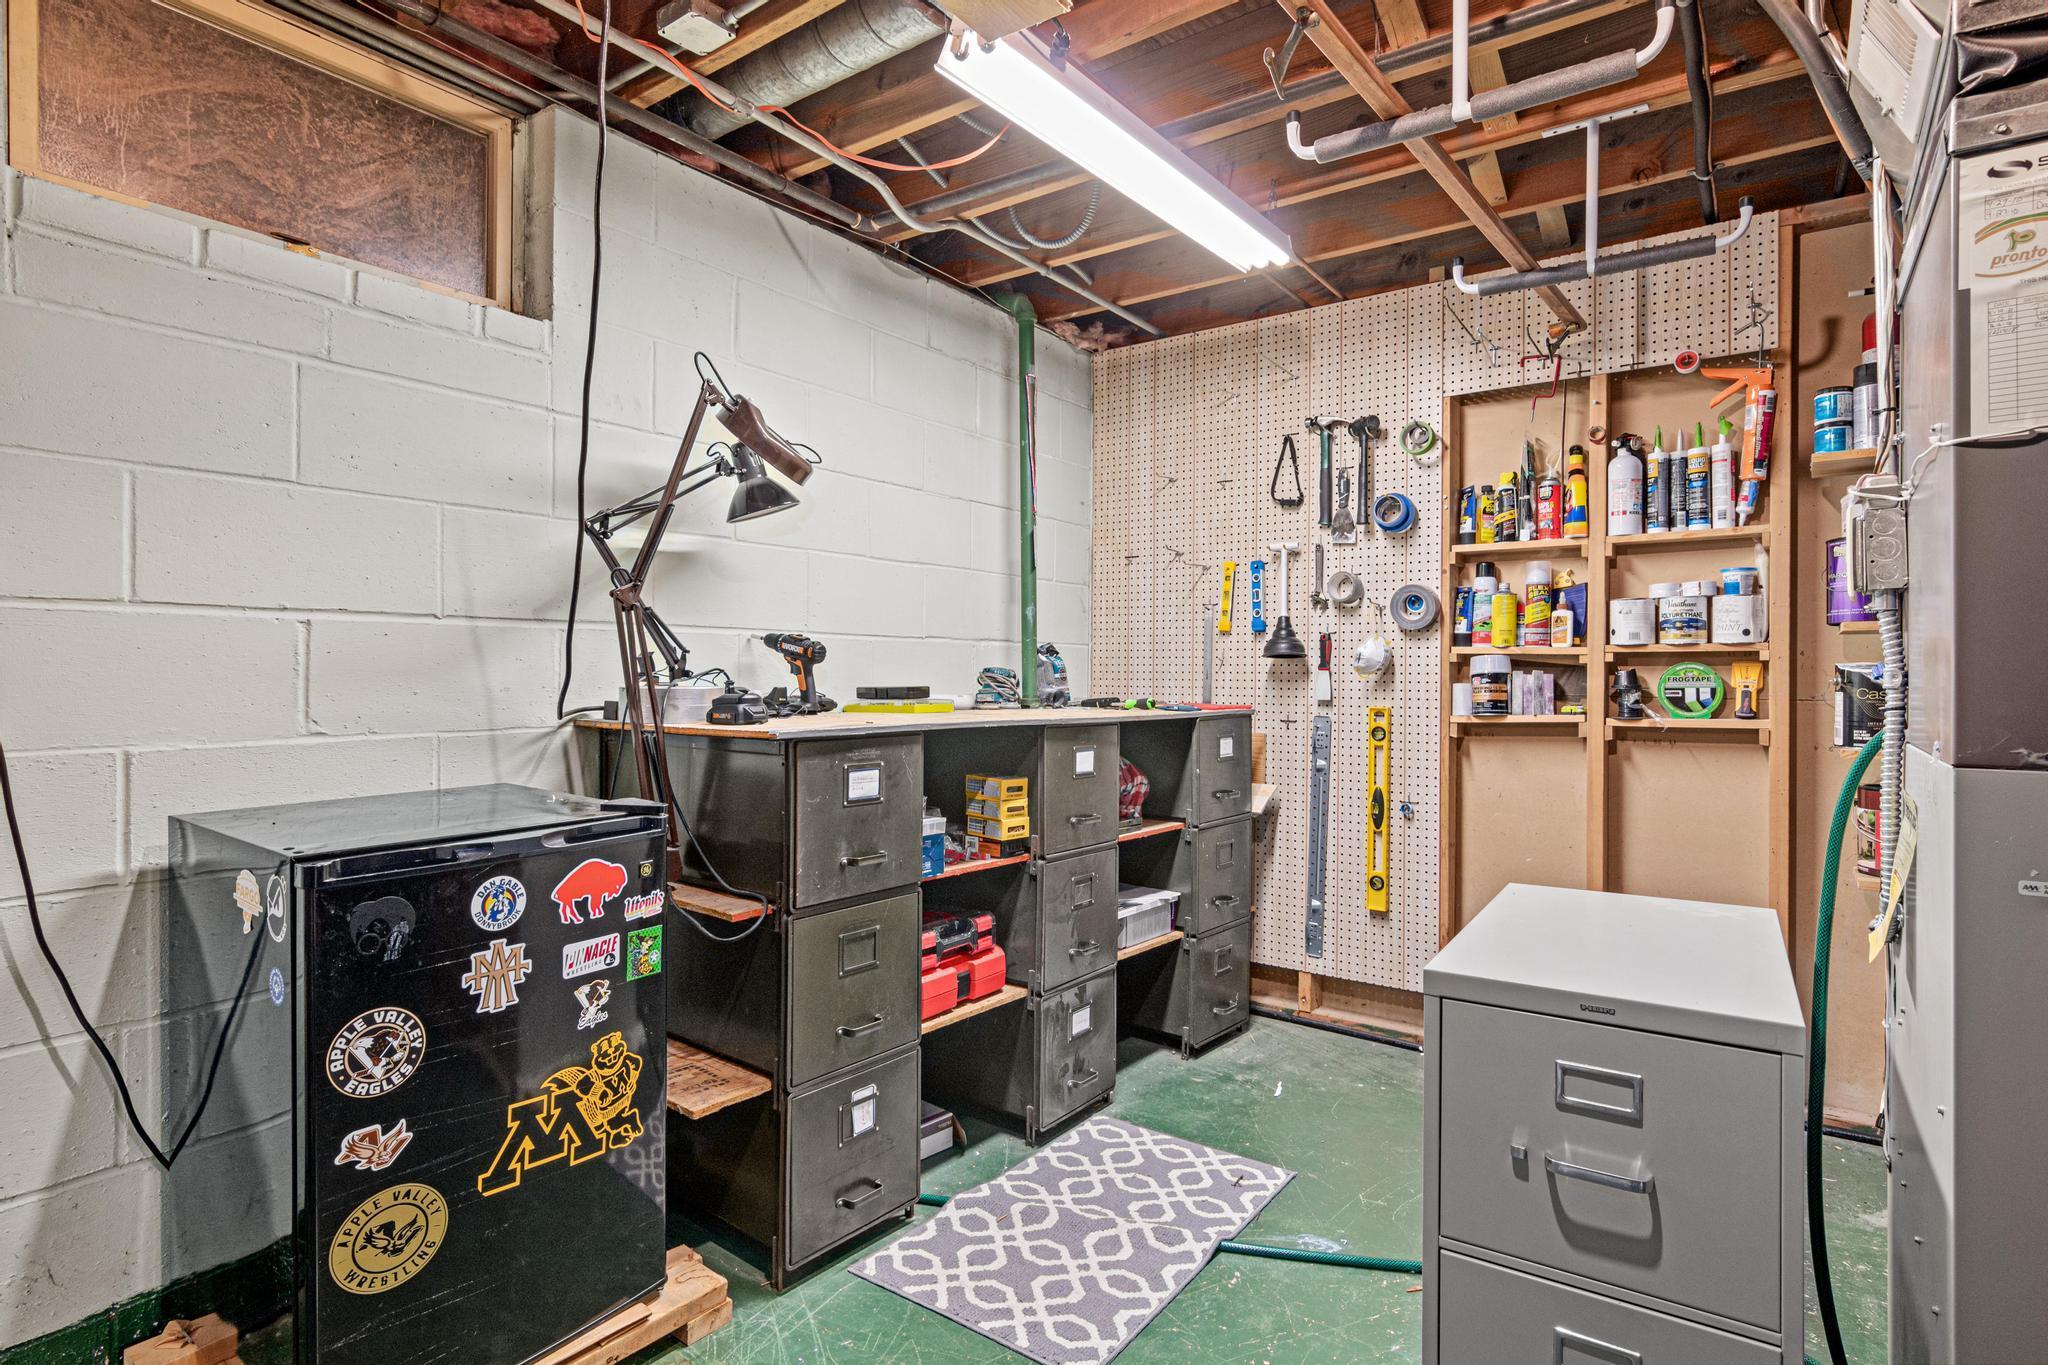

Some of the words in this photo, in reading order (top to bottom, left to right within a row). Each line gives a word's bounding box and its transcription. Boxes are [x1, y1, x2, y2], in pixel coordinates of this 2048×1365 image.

[1990, 246, 2048, 269] pronto
[476, 881, 497, 899] DAN
[500, 879, 525, 899] GABLE
[474, 909, 521, 930] DONNYBROOK
[565, 935, 618, 970] PINNACLE
[566, 960, 603, 977] WRESTLING
[578, 1011, 608, 1029] Eagles
[330, 1018, 367, 1074] APPLE
[373, 1011, 424, 1050] VALLEY
[344, 1063, 414, 1097] EAGLES
[337, 1198, 383, 1249] APPLE
[392, 1190, 444, 1218] VALLEY
[344, 1239, 437, 1290] WRESTLING
